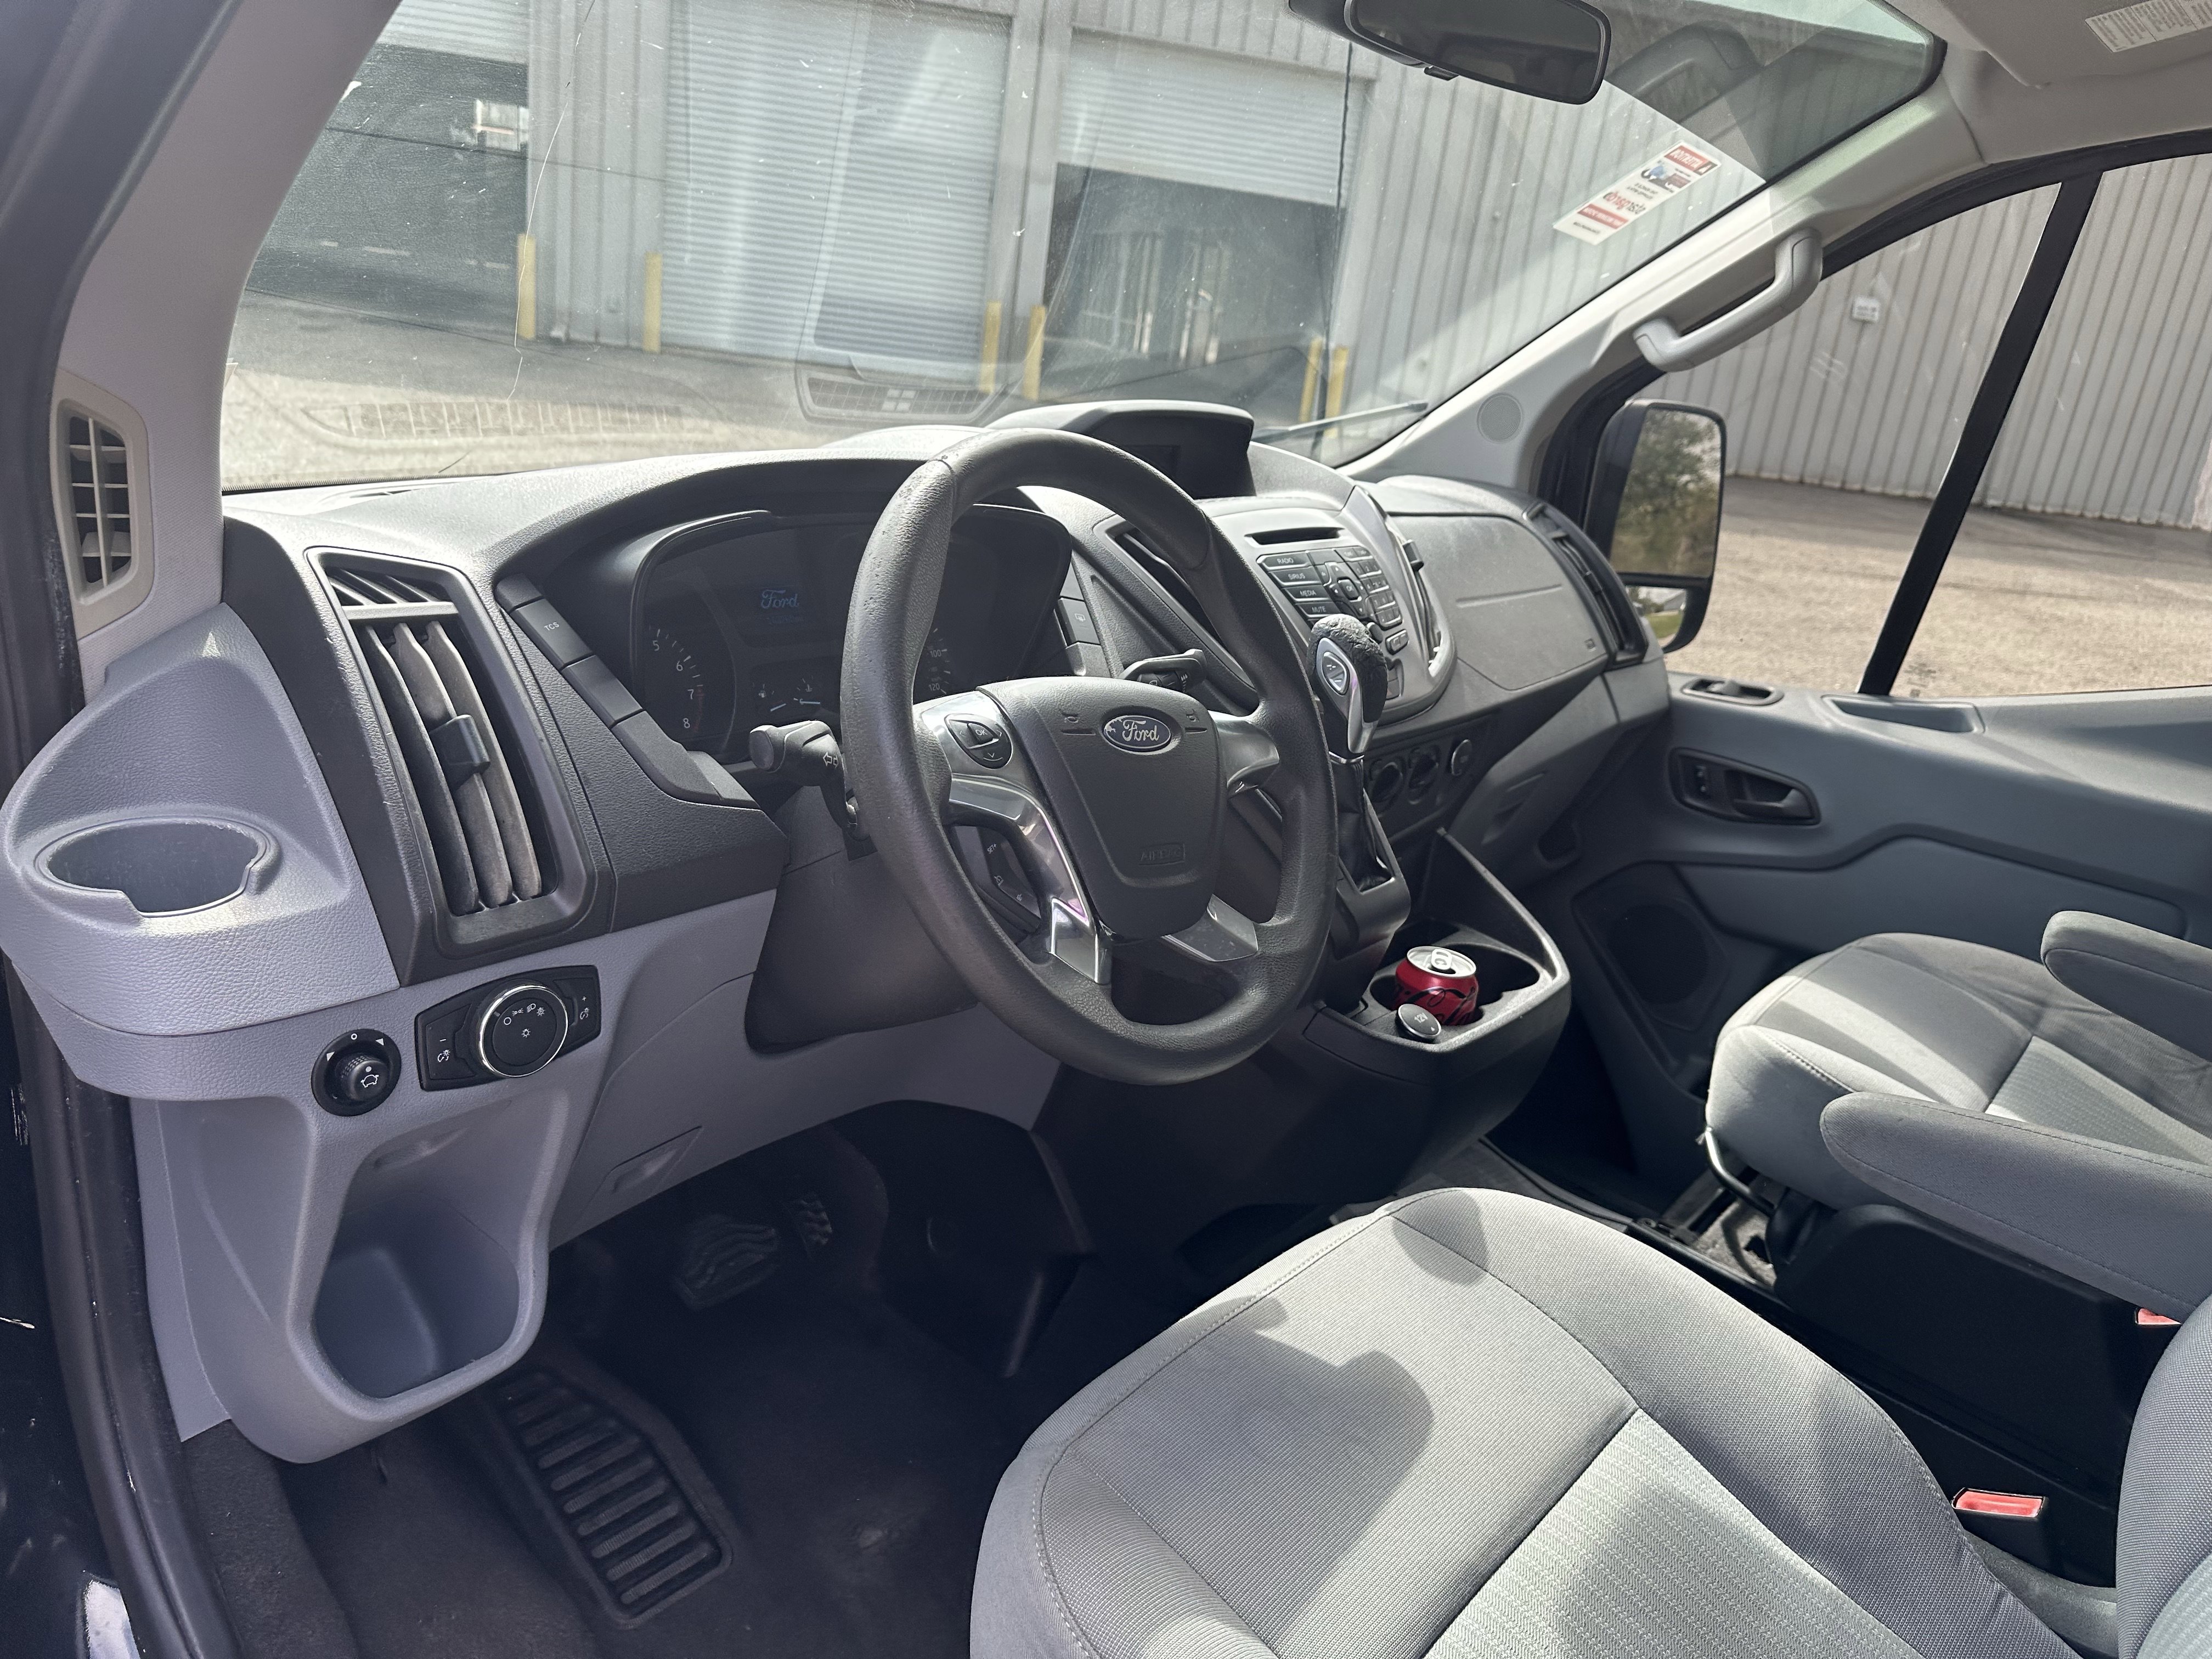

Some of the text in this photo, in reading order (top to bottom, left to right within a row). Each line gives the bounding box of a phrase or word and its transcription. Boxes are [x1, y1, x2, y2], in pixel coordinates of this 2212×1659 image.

[761, 589, 799, 609] Ford
[544, 622, 560, 631] TCS
[652, 640, 660, 651] 5
[930, 649, 941, 657] 100
[676, 661, 683, 671] 6
[929, 683, 940, 691] 120
[687, 689, 694, 700] 7
[683, 718, 691, 729] 8
[1122, 719, 1160, 741] Ford
[1414, 1012, 1428, 1023] 12V
